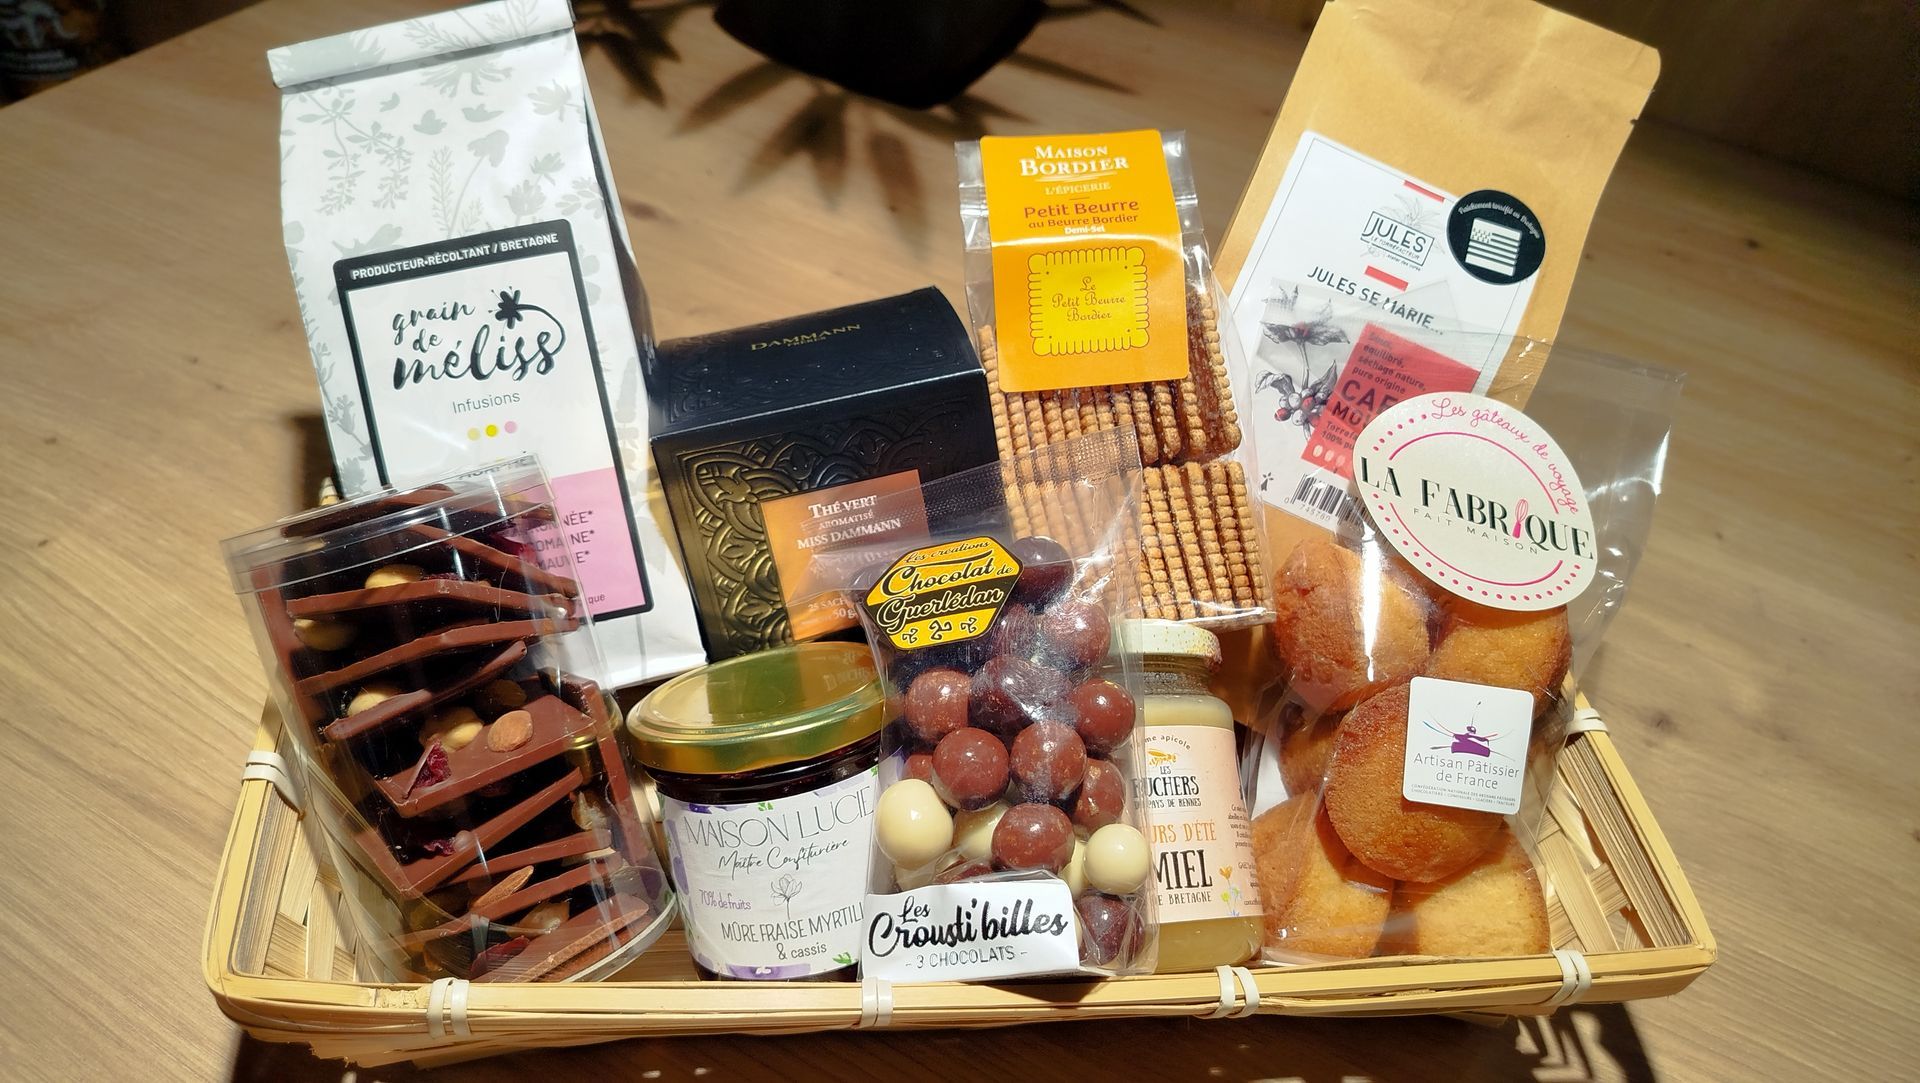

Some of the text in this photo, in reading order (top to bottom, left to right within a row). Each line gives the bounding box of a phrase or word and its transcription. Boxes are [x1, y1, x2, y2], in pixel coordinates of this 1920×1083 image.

[1035, 145, 1108, 159] MAISON
[1020, 157, 1129, 176] BORDIER
[1024, 200, 1139, 219] Petit Beurre
[1048, 218, 1089, 227] Beurre
[1092, 214, 1138, 225] Bordier
[501, 233, 559, 252] BRETAGNE
[1361, 217, 1426, 253] JULES
[1080, 276, 1096, 291] Le
[1307, 266, 1357, 295] JULES
[1360, 288, 1381, 306] SE
[1051, 291, 1126, 308] Petit Beurre
[392, 301, 476, 346] grain
[1067, 307, 1112, 321] Bordier
[413, 328, 443, 353] de
[751, 324, 860, 351] DAMMANN
[1352, 365, 1406, 395] pure origine
[452, 392, 521, 414] Infusions
[1341, 380, 1399, 415] CAF
[1431, 398, 1579, 514] Les gâteaux de voyage
[1361, 456, 1401, 498] LA
[808, 495, 877, 519] THÉ VERT
[819, 509, 874, 530] AROMATISÉ
[1413, 508, 1538, 555] FAIT MAISON
[797, 518, 902, 550] MISS DAMMANN
[881, 553, 995, 597] Chocolat
[997, 564, 1013, 576] de
[877, 585, 1004, 634] Guerlédan
[1160, 734, 1191, 750] apicole
[1160, 766, 1171, 775] LES
[1413, 753, 1519, 778] Artisan Pâtissier
[1436, 770, 1498, 789] de France
[1168, 799, 1175, 807] DE
[1178, 798, 1201, 807] RENNES
[684, 786, 874, 848] MAISON LUCIE
[1184, 819, 1216, 841] D'ÉTÉ
[719, 839, 849, 880] Maître Confiturière
[1153, 850, 1212, 890] MIEL
[699, 889, 717, 905] 70%
[1169, 891, 1212, 905] BRETAGNE
[898, 895, 930, 924] Les
[721, 921, 759, 943] MÛRE
[760, 919, 807, 942] FRAISE
[776, 942, 827, 960] & cassis
[917, 955, 924, 969] 3
[929, 946, 1015, 967] CHOCOLATS
